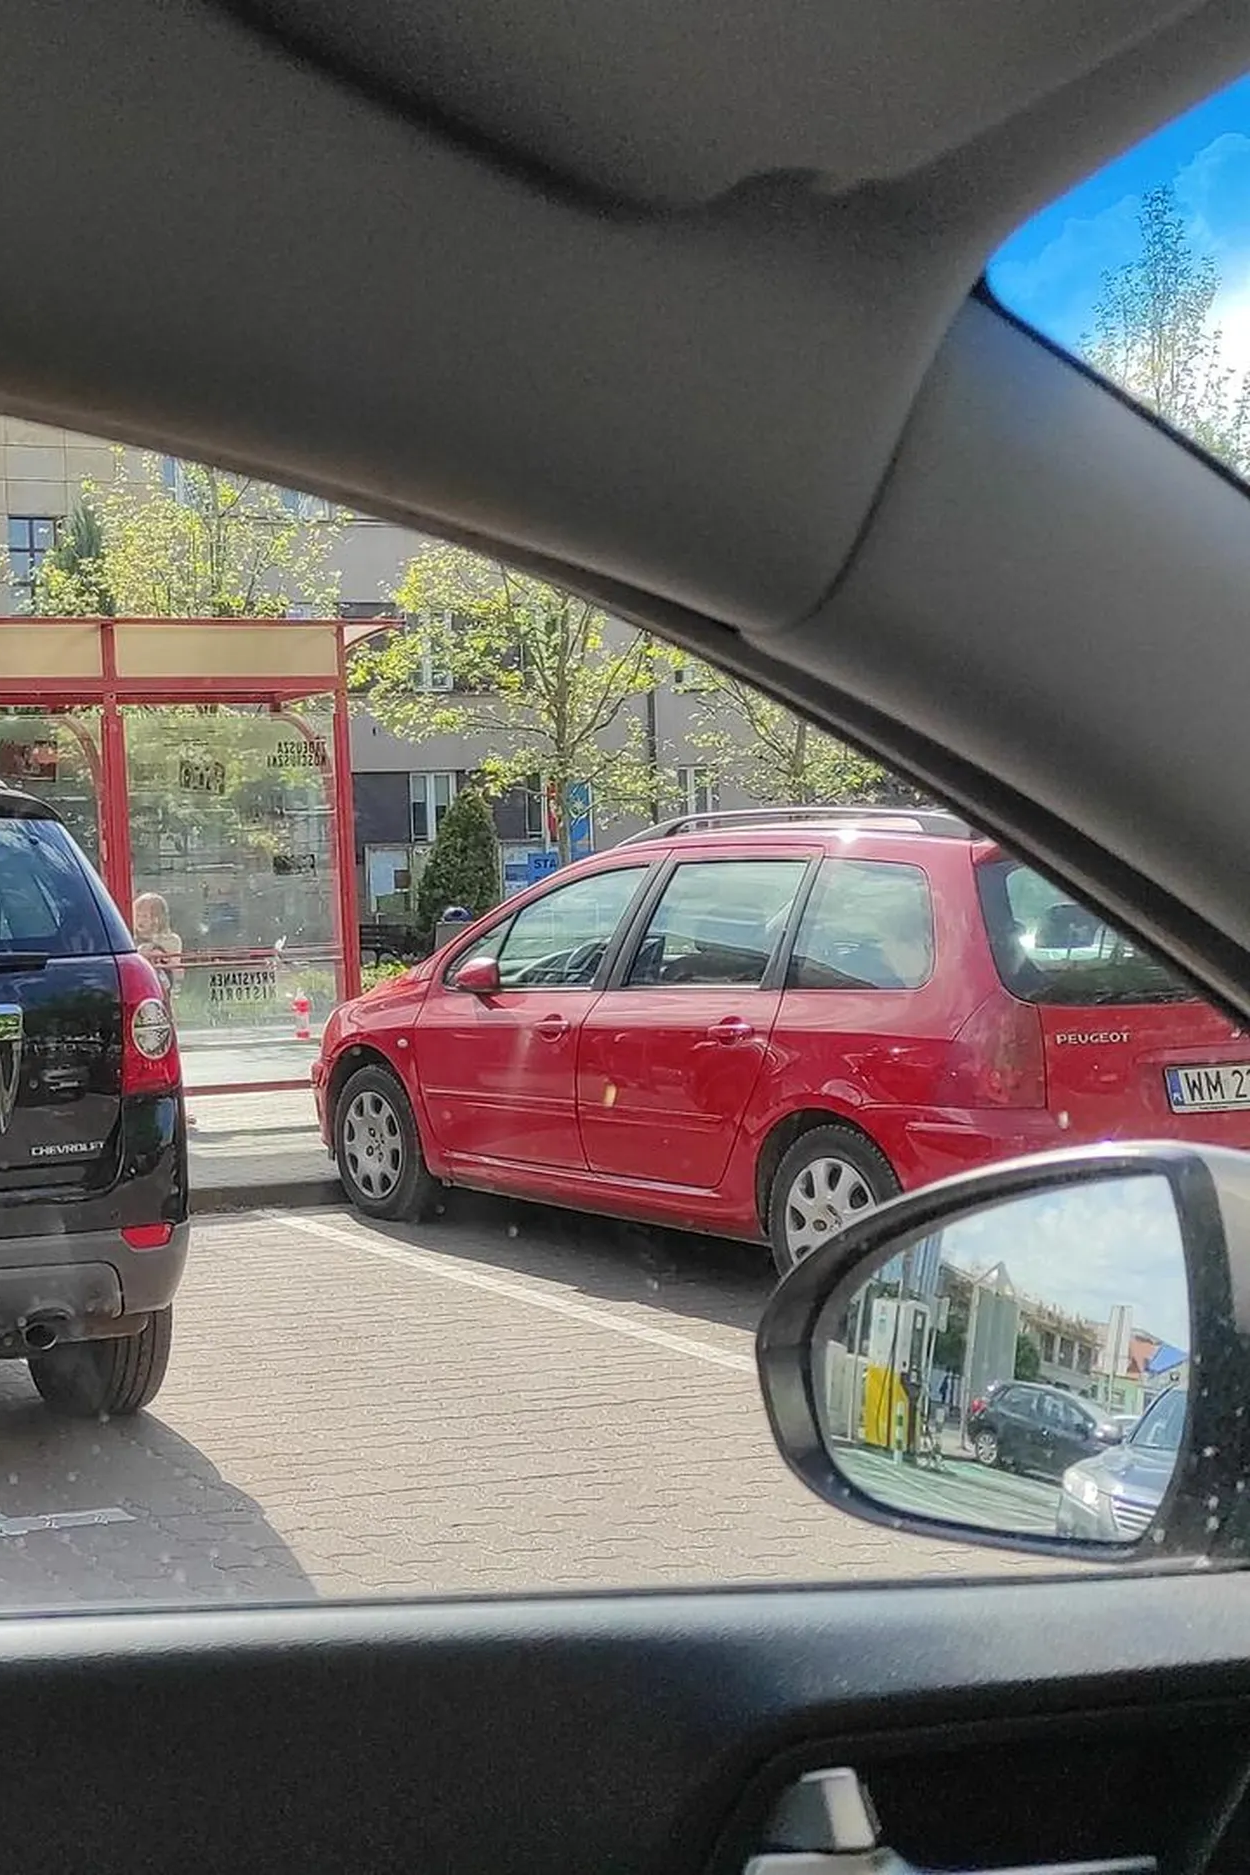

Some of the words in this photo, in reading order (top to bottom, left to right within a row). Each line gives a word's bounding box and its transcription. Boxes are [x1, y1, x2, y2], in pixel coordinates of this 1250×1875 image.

[1056, 1032, 1130, 1044] PEUGEOT
[1184, 1070, 1225, 1102] WM
[1231, 1069, 1250, 1099] 2
[31, 1141, 105, 1156] CHEVROLET
